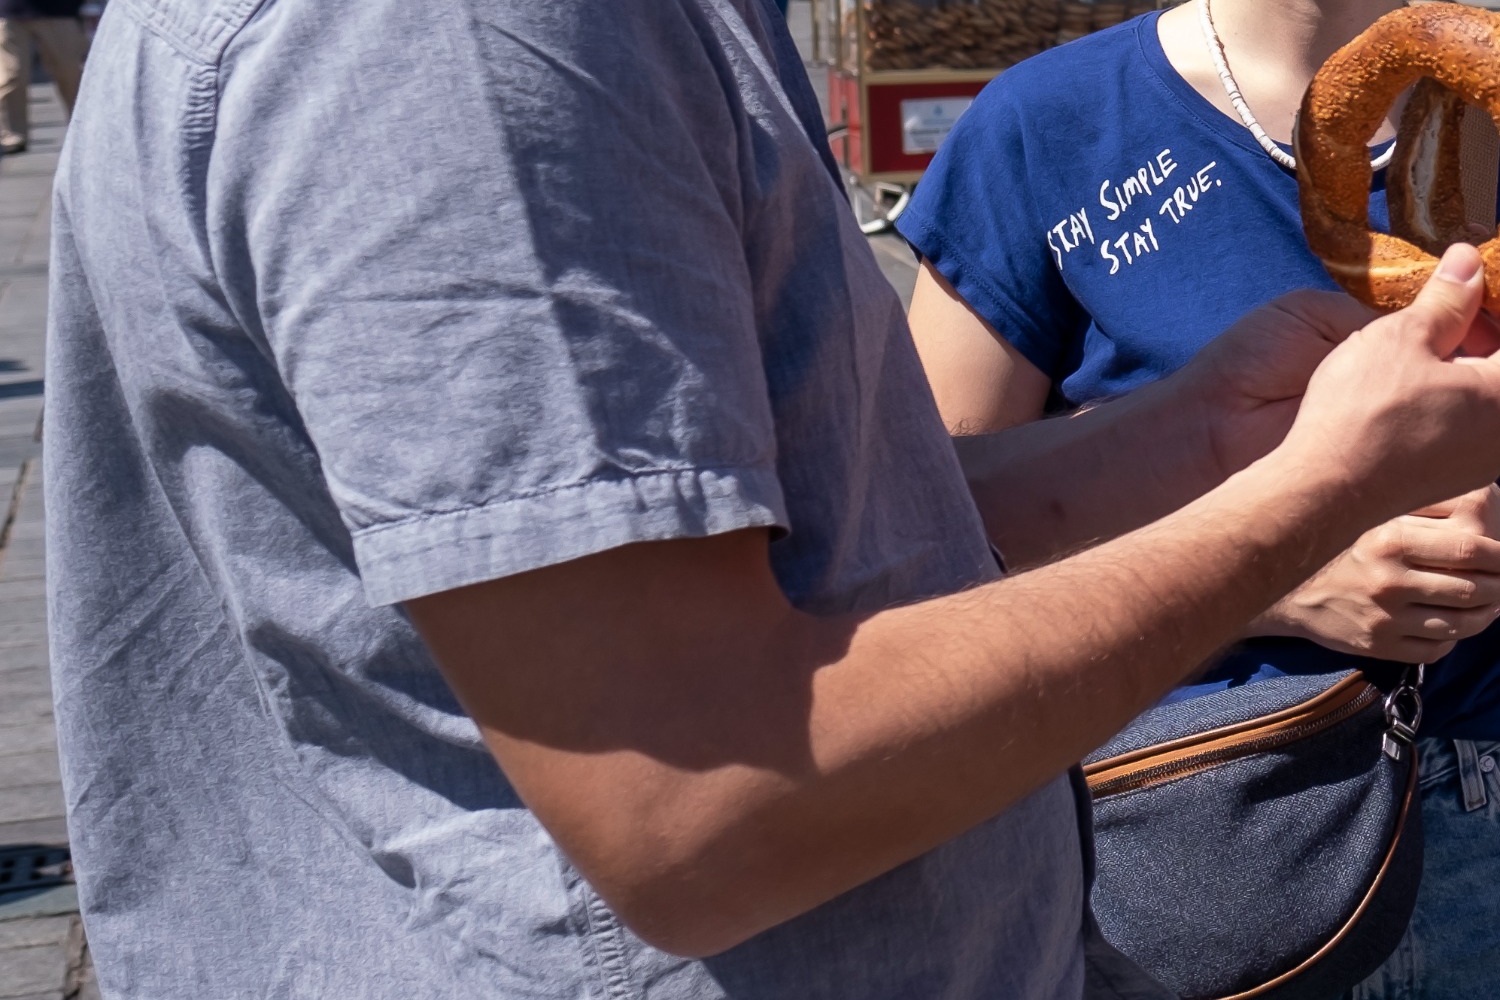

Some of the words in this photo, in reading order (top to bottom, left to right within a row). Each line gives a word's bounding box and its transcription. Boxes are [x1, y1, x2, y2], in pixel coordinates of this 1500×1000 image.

[1047, 207, 1095, 270] STAY
[1100, 217, 1159, 275] STAY
[1158, 160, 1223, 225] TRUE.
